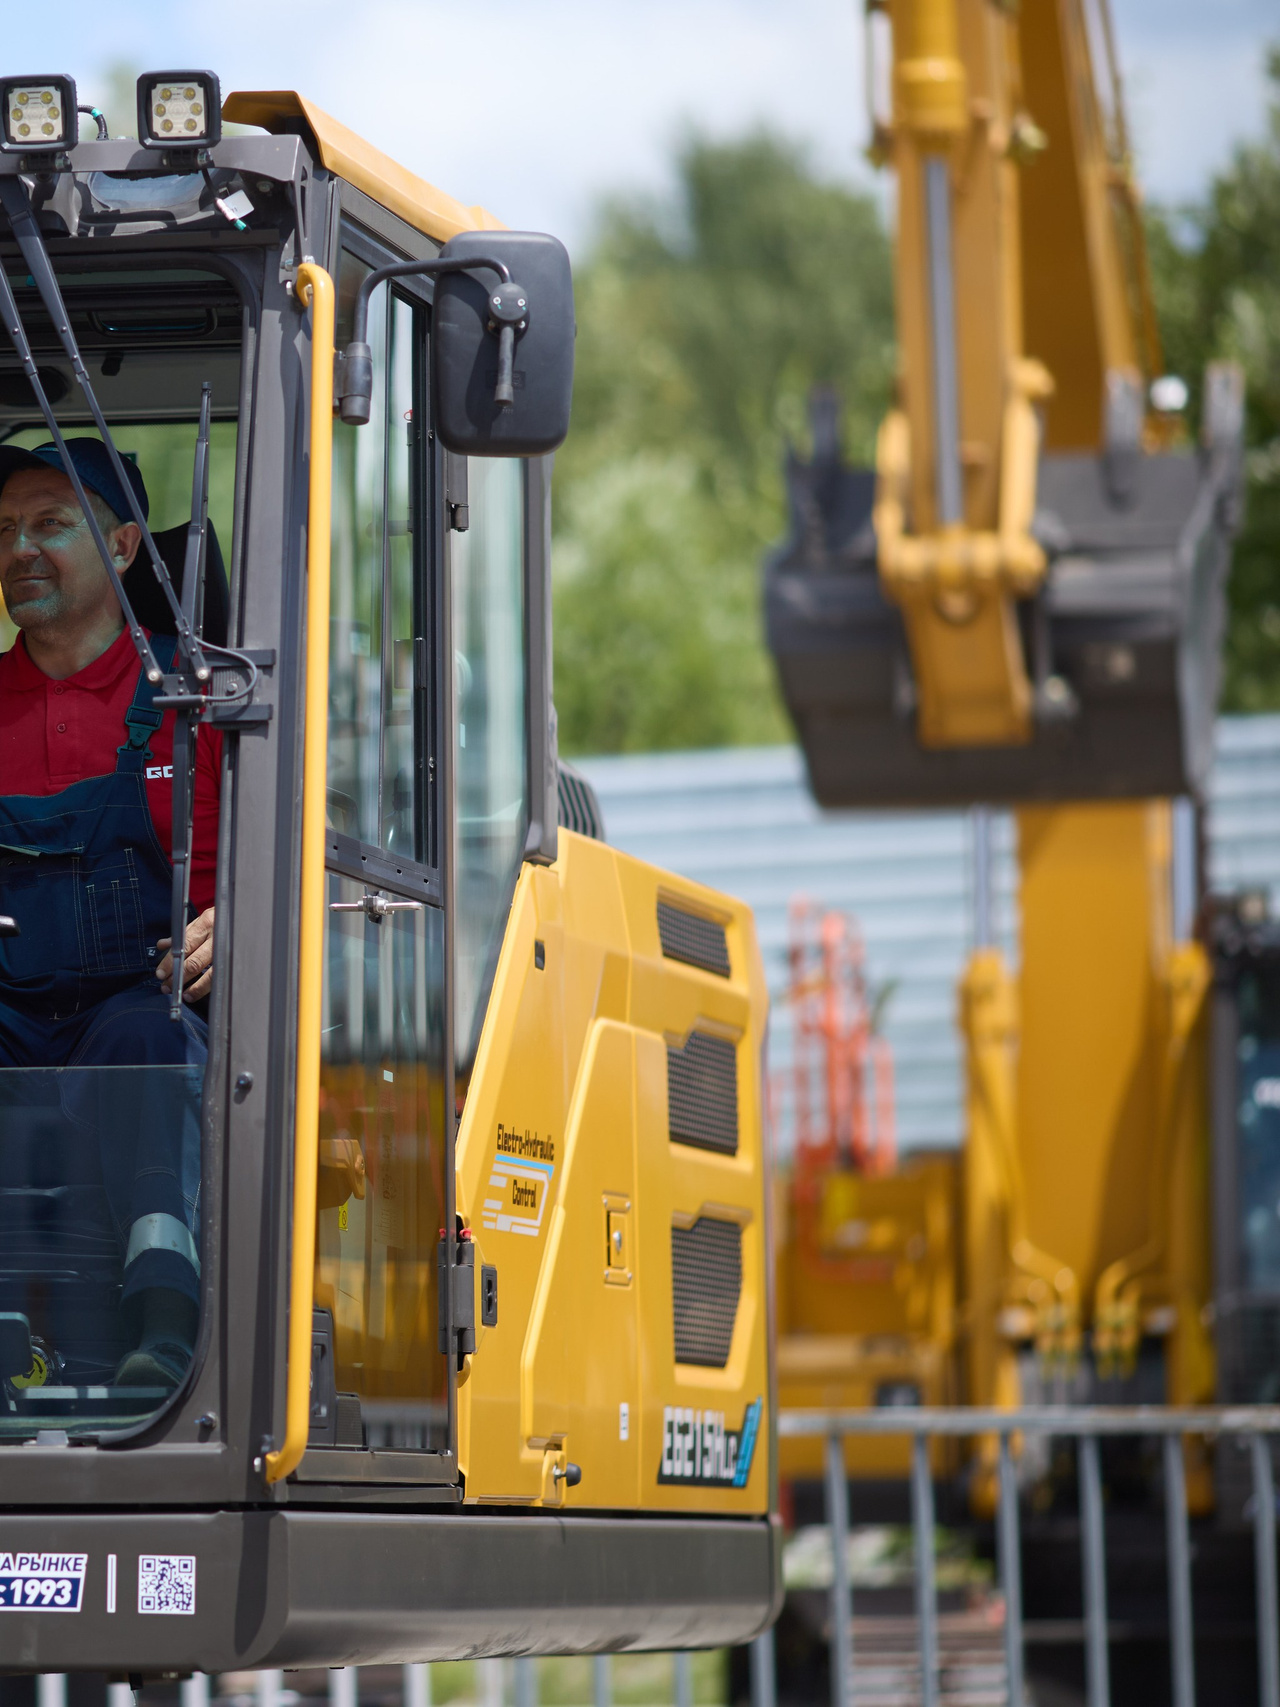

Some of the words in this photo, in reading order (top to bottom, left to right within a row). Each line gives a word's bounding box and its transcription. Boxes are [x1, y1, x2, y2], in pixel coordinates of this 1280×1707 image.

[496, 1123, 555, 1162] Electro-Hydraulic
[512, 1179, 537, 1208] Control
[17, 1556, 84, 1572] РЫНКЕ
[10, 1578, 72, 1605] 1993
